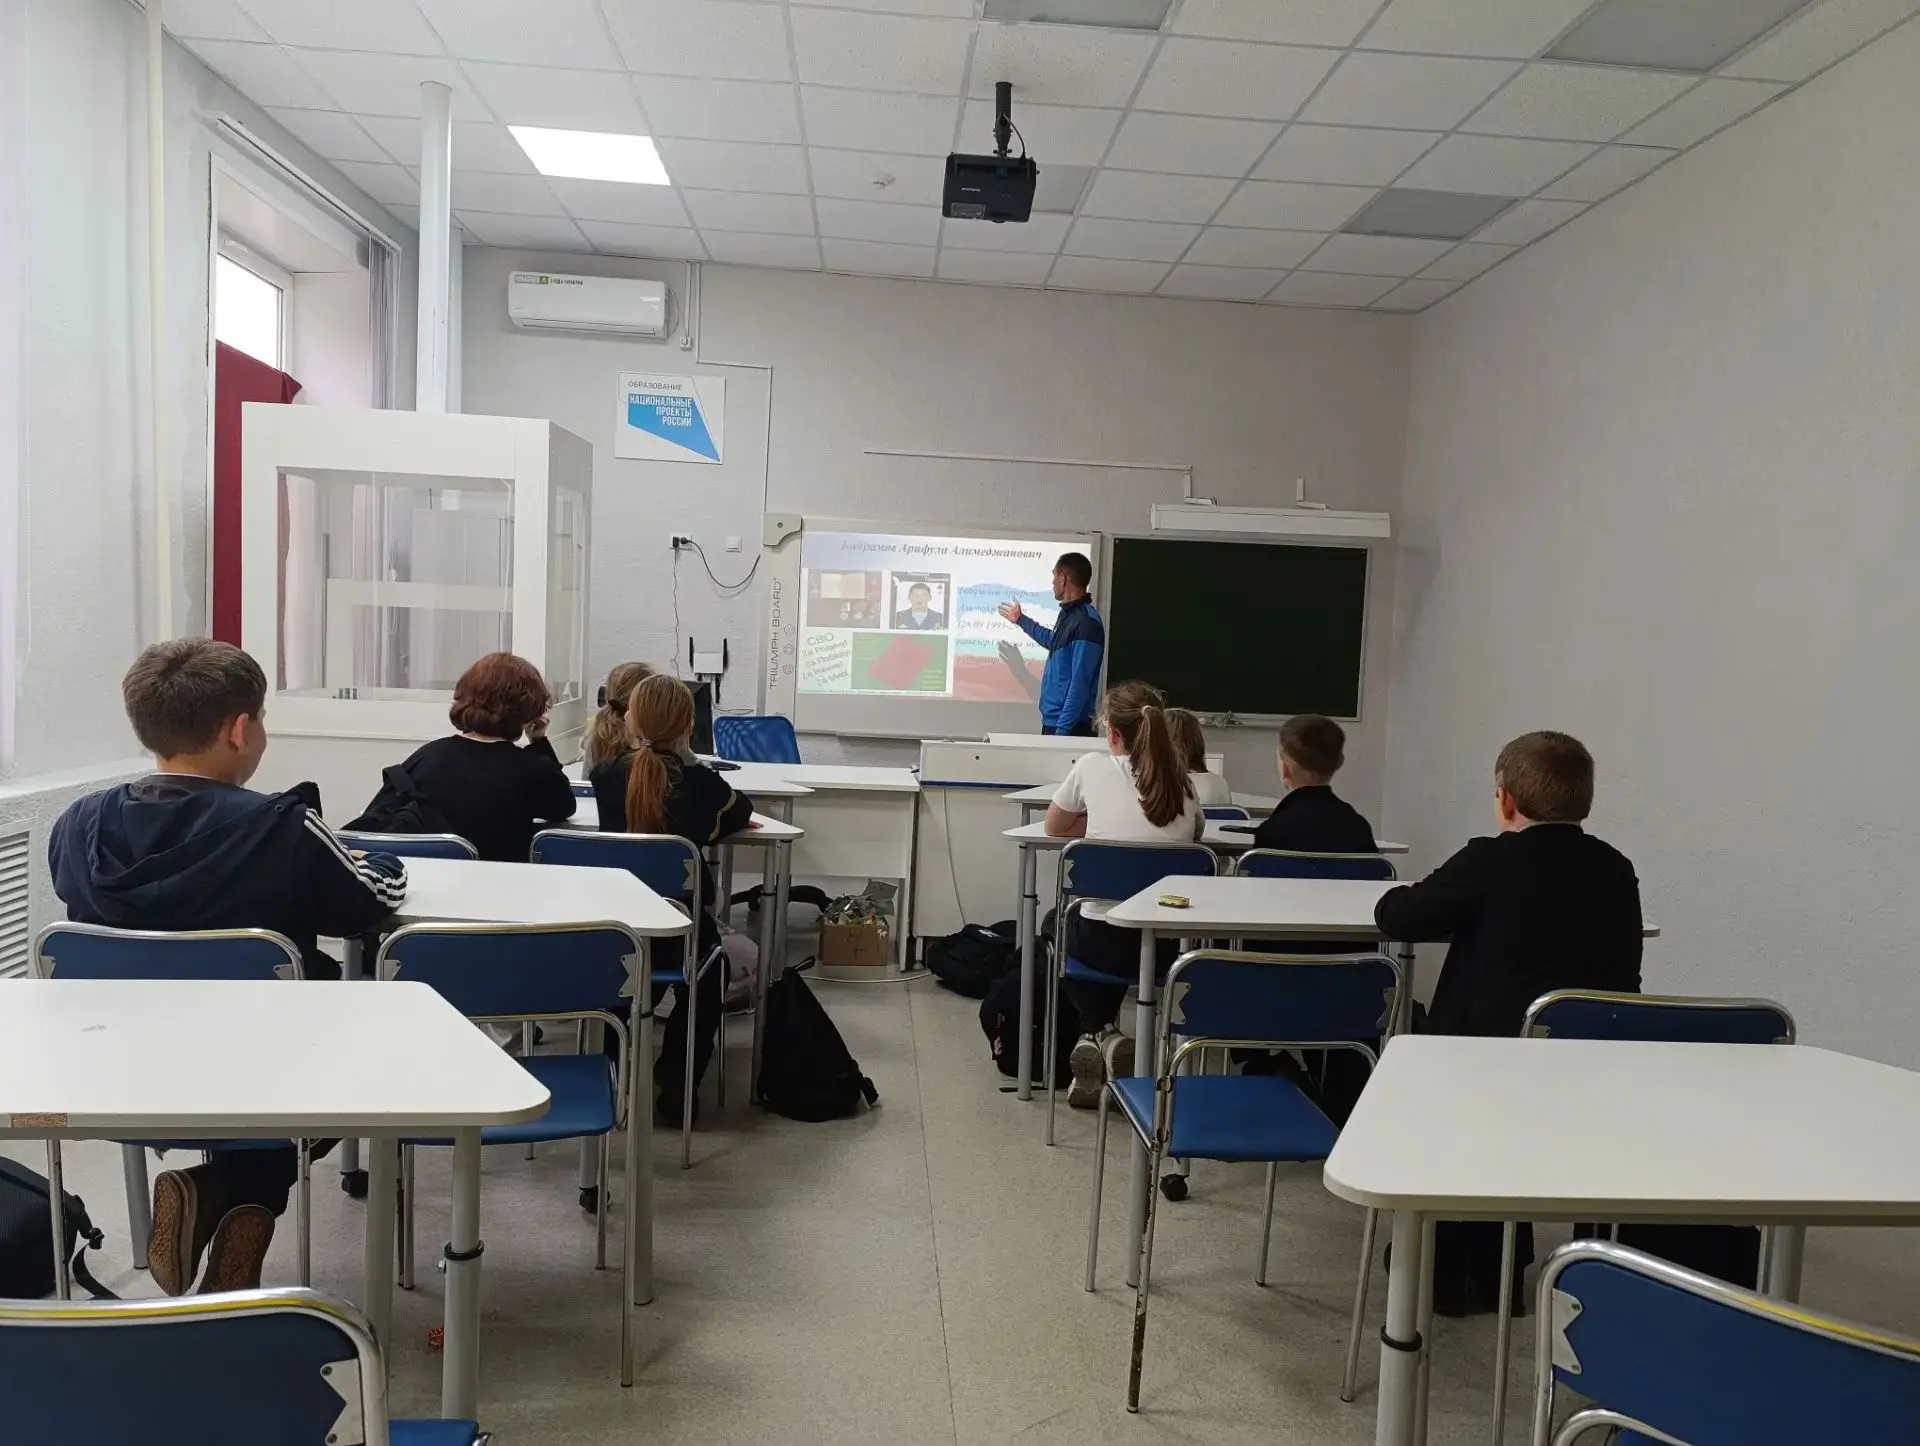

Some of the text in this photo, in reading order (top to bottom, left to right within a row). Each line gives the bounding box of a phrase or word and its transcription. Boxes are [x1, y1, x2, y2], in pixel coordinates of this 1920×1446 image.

[628, 381, 682, 390] ОБРАЗОВАНИЕ
[629, 394, 692, 408] НАЦИОНАЛЬНЫЕ
[656, 406, 692, 417] ПРОЕКТЫ
[662, 416, 692, 427] РОССИИ
[769, 632, 779, 690] TRIUMPH
